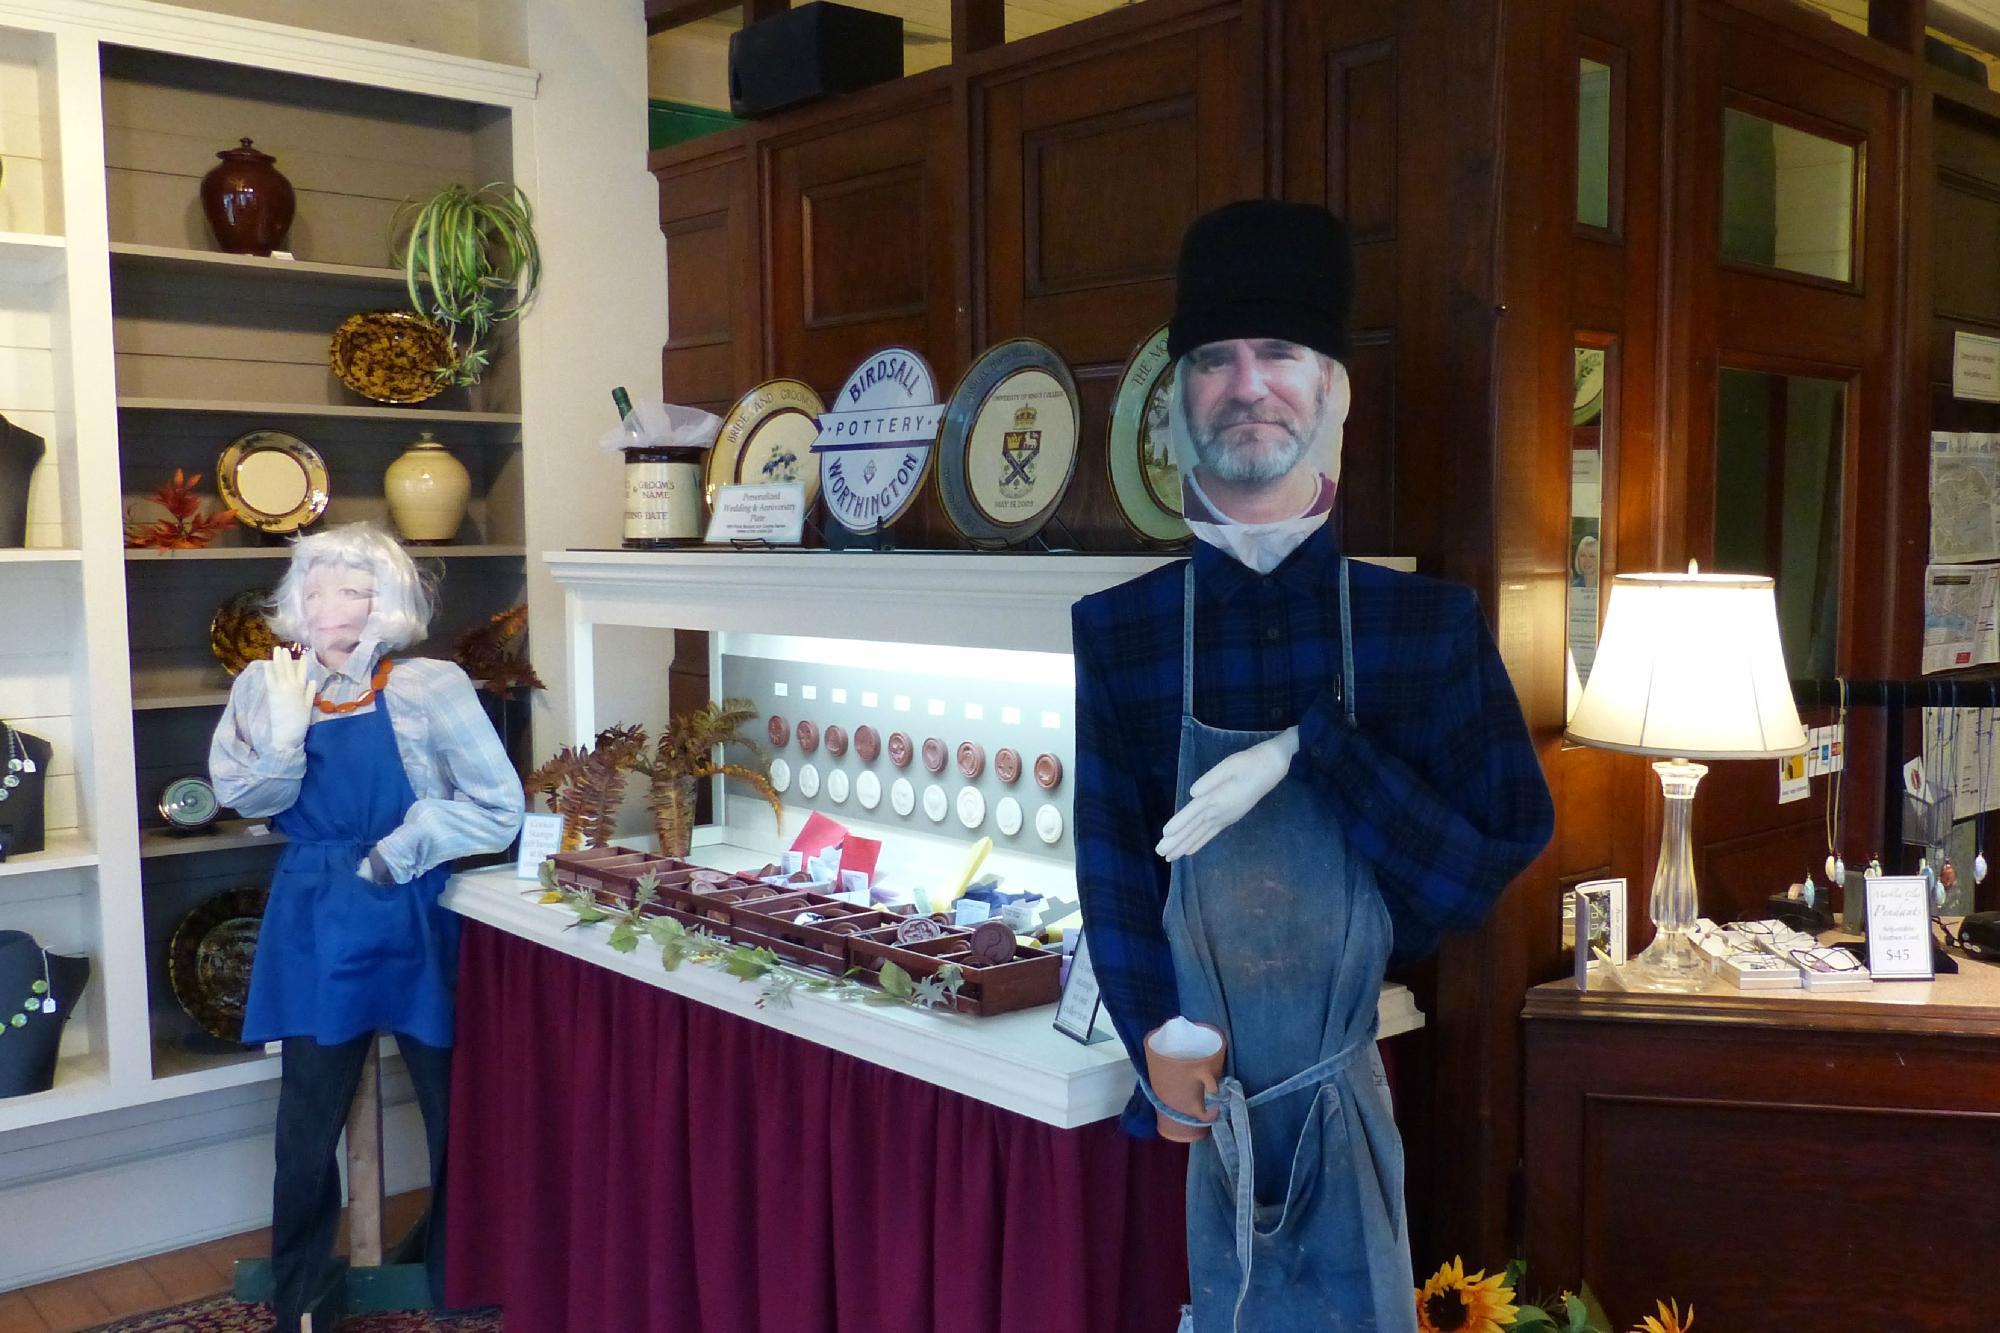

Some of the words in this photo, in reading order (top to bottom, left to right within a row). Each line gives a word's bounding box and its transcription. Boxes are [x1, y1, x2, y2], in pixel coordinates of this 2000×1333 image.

[849, 357, 920, 405] BIRDSALL
[1131, 358, 1153, 387] THE
[726, 413, 750, 444] BRIDE
[752, 392, 774, 413] AND
[836, 415, 925, 437] POTTERY
[828, 451, 919, 520] WORTHINGTON
[642, 491, 671, 499] NAME
[743, 491, 781, 502] Personalized
[645, 511, 669, 520] DATE
[724, 503, 752, 514] Wedding
[759, 502, 796, 513] Anniversary
[1886, 949, 1910, 961] $45
